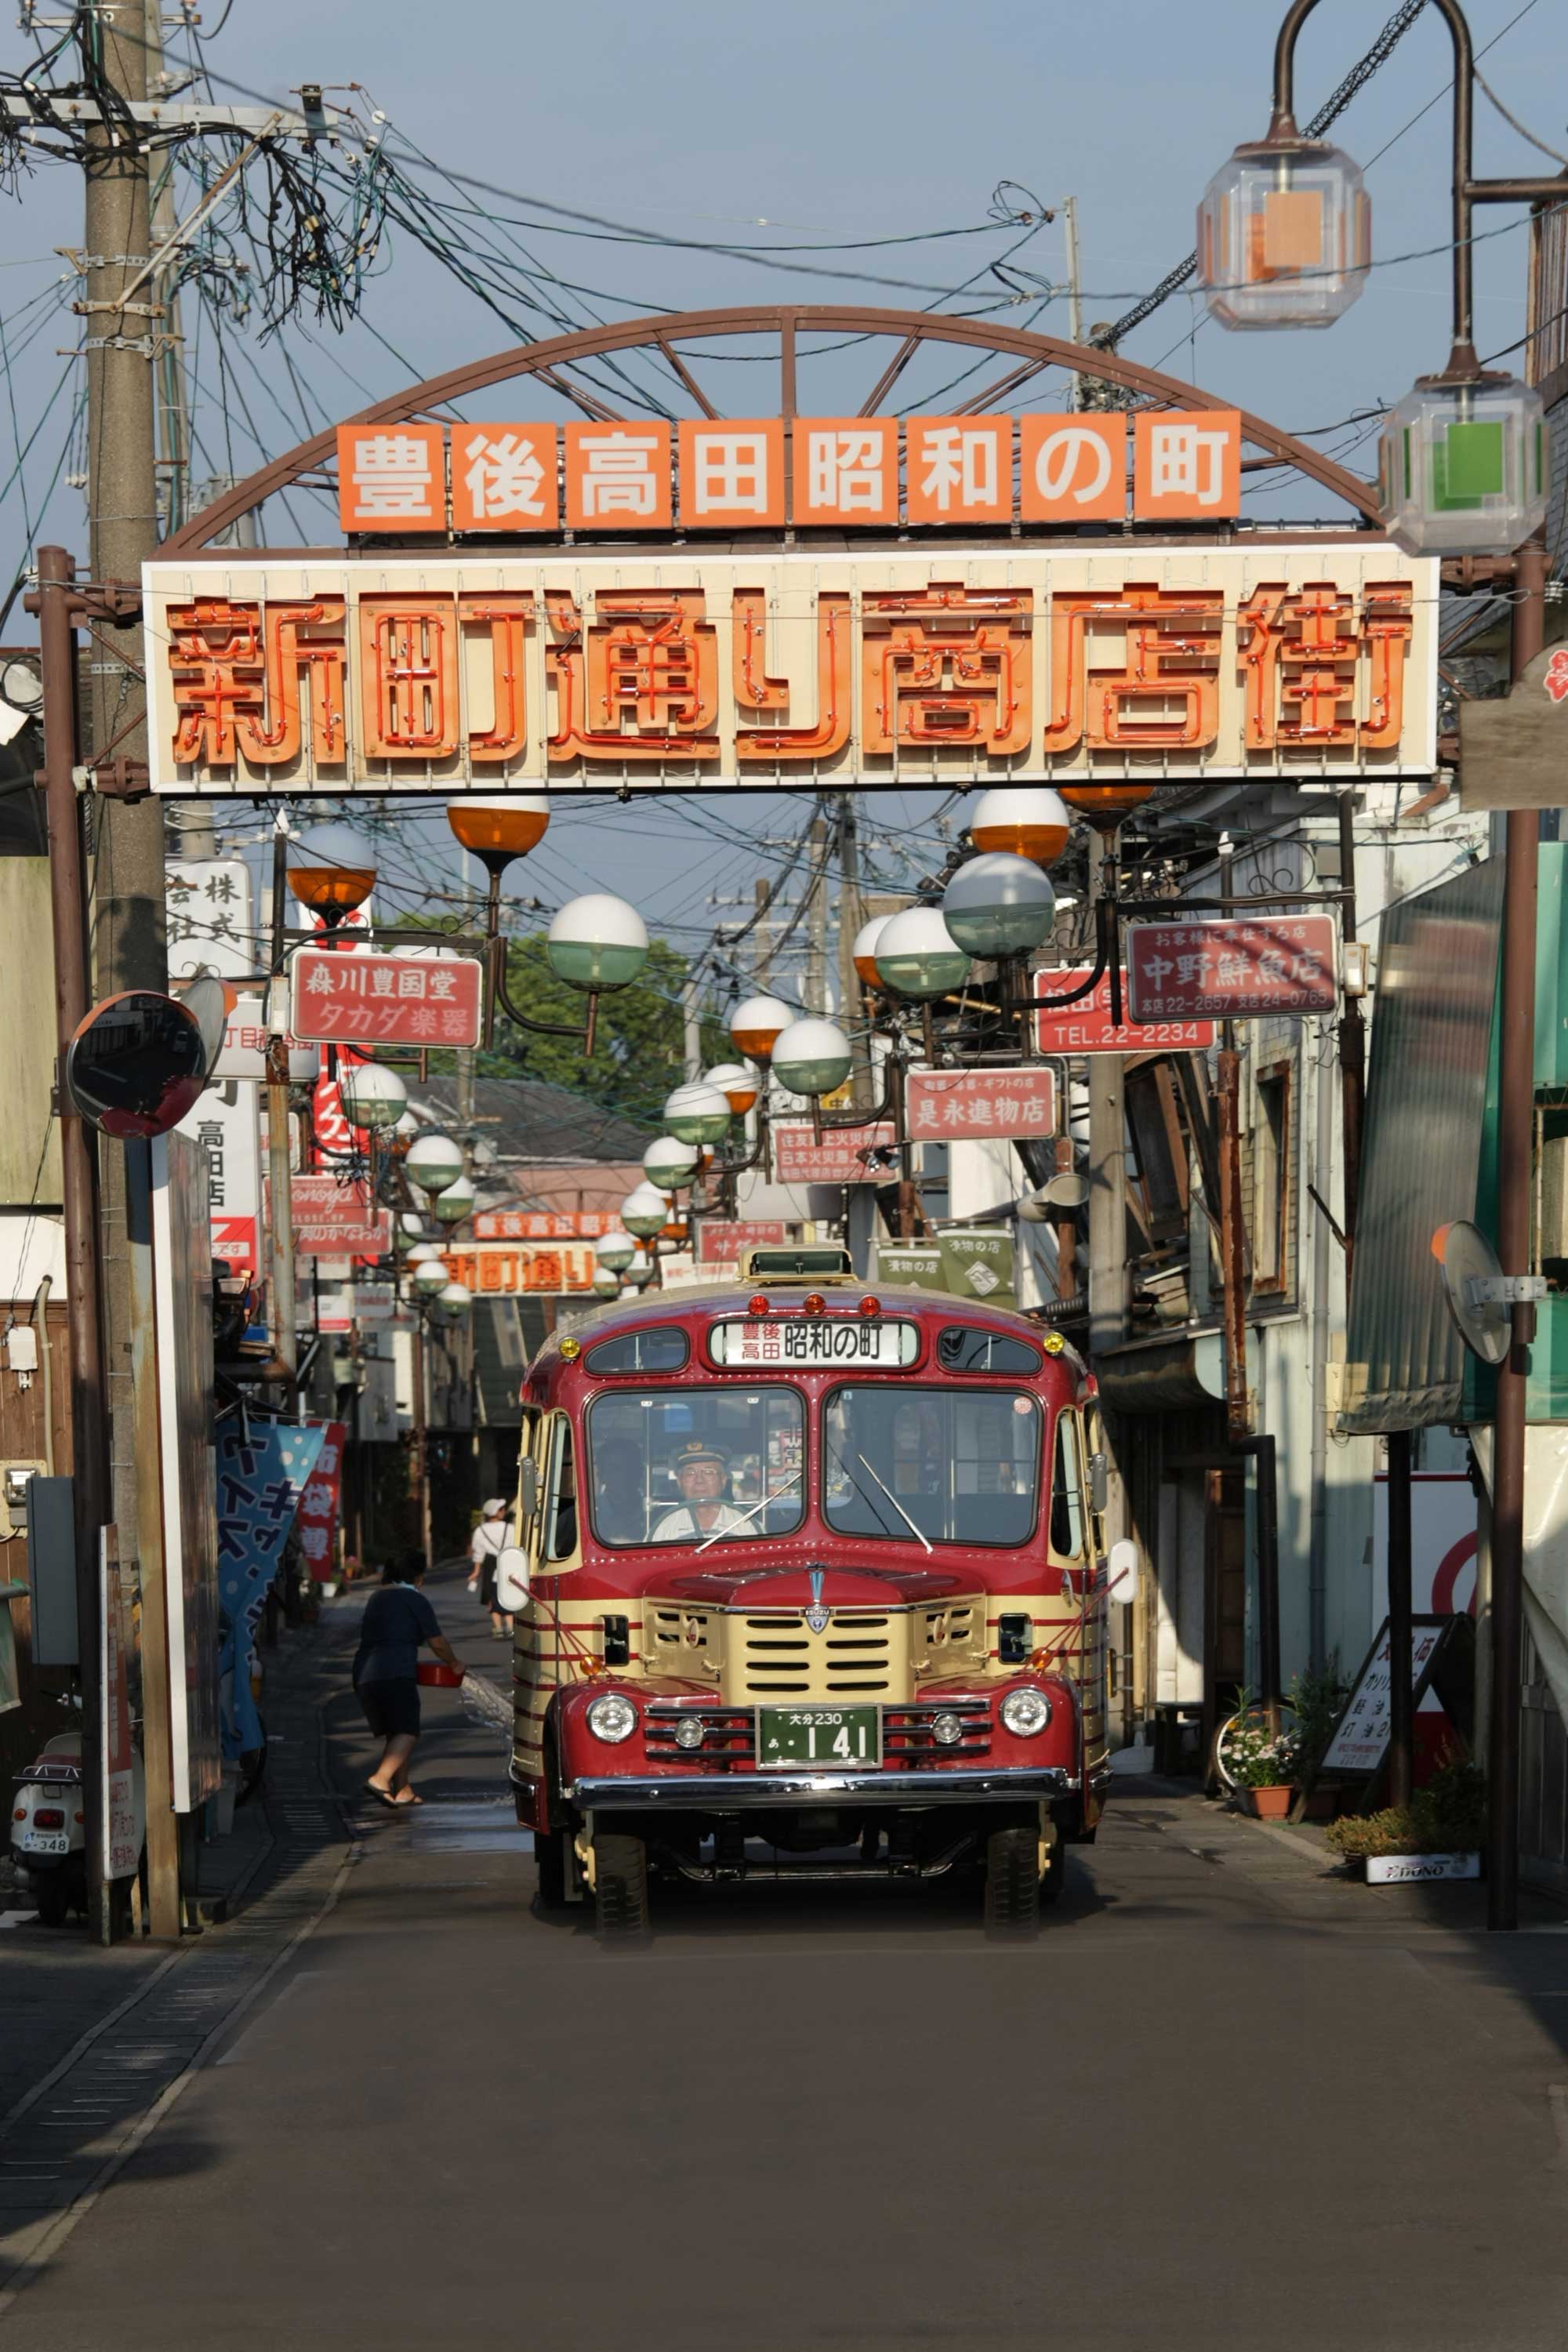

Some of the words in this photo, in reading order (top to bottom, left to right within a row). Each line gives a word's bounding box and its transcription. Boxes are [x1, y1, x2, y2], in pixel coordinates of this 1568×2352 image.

[351, 425, 1229, 519] 豊後高田昭和の町
[166, 581, 1413, 764] 新町通り商店街
[305, 962, 457, 1002] 森川豊国堂
[1142, 947, 1324, 991] 中野鮮魚店
[319, 1001, 468, 1037] タカダ楽器
[1054, 1023, 1198, 1045] TEL.22-2234
[916, 1096, 1046, 1128] 是永進物店
[291, 1187, 354, 1214] onoya
[785, 1323, 883, 1359] 昭和の町
[789, 1713, 843, 1726] 大分230
[768, 1737, 779, 1749] あ
[39, 1839, 66, 1851] 348
